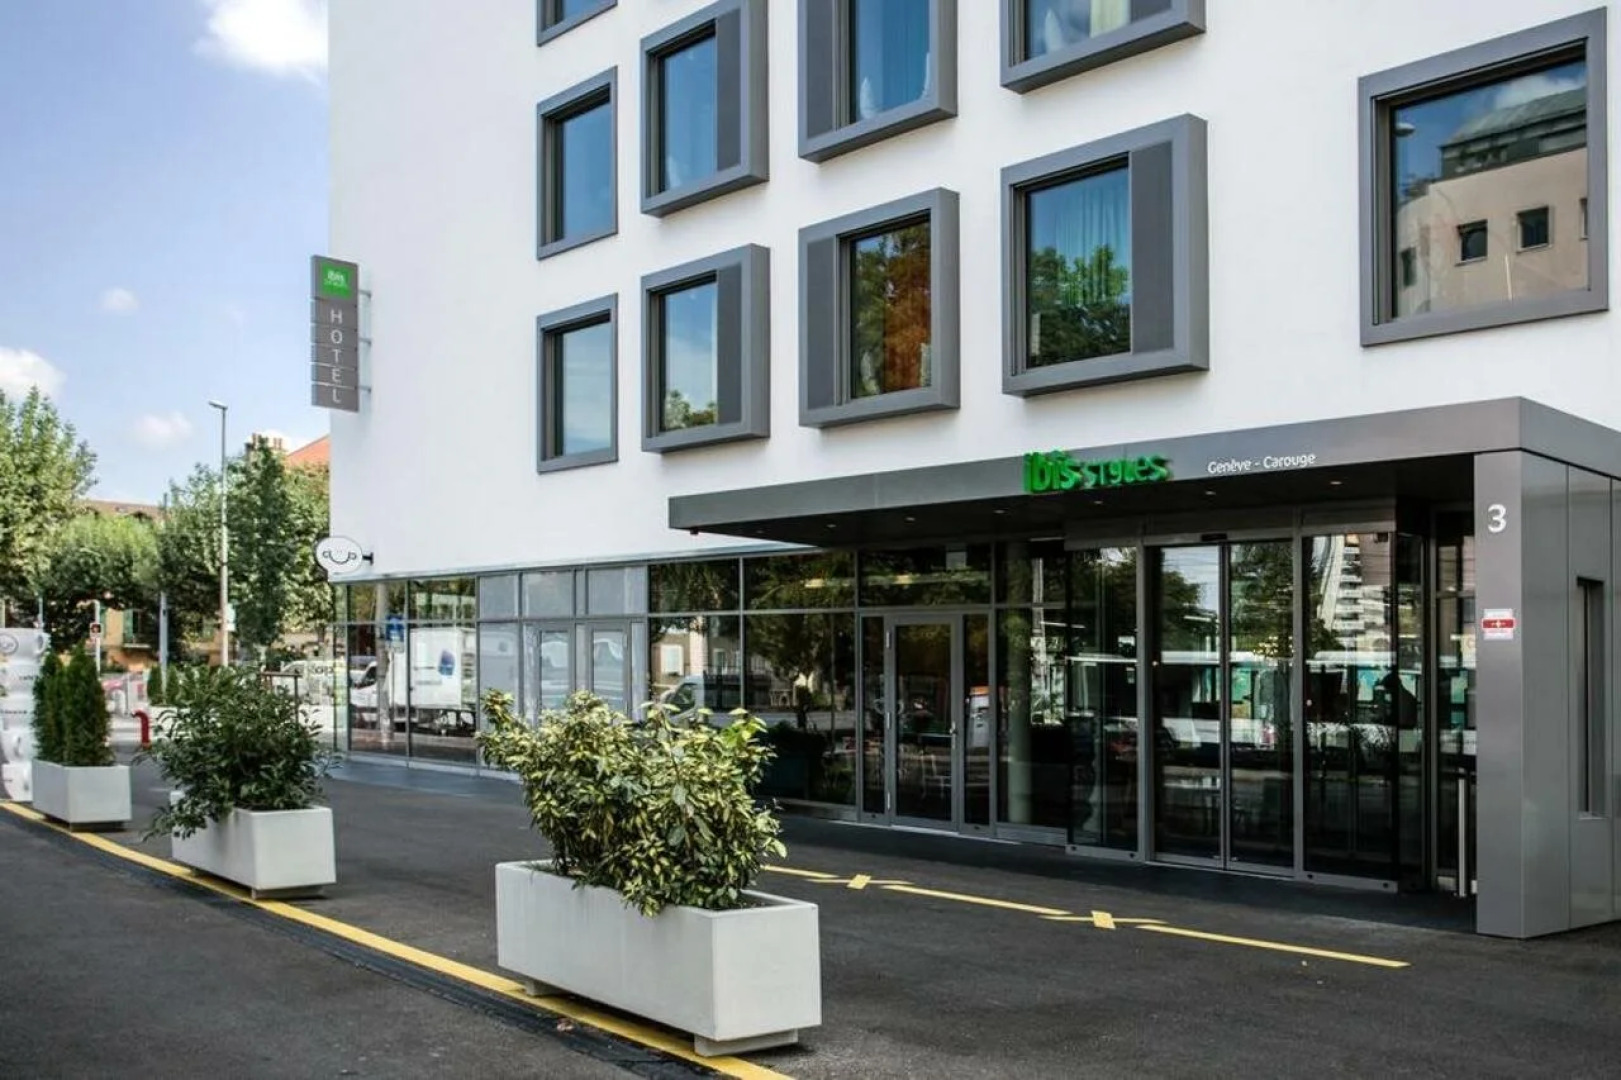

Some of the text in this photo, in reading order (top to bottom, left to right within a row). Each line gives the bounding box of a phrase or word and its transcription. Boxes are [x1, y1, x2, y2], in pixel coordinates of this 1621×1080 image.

[331, 309, 342, 403] HOTEL
[1207, 458, 1252, 474] Genève
[1263, 453, 1317, 469] Carouge
[1487, 503, 1507, 533] 3
